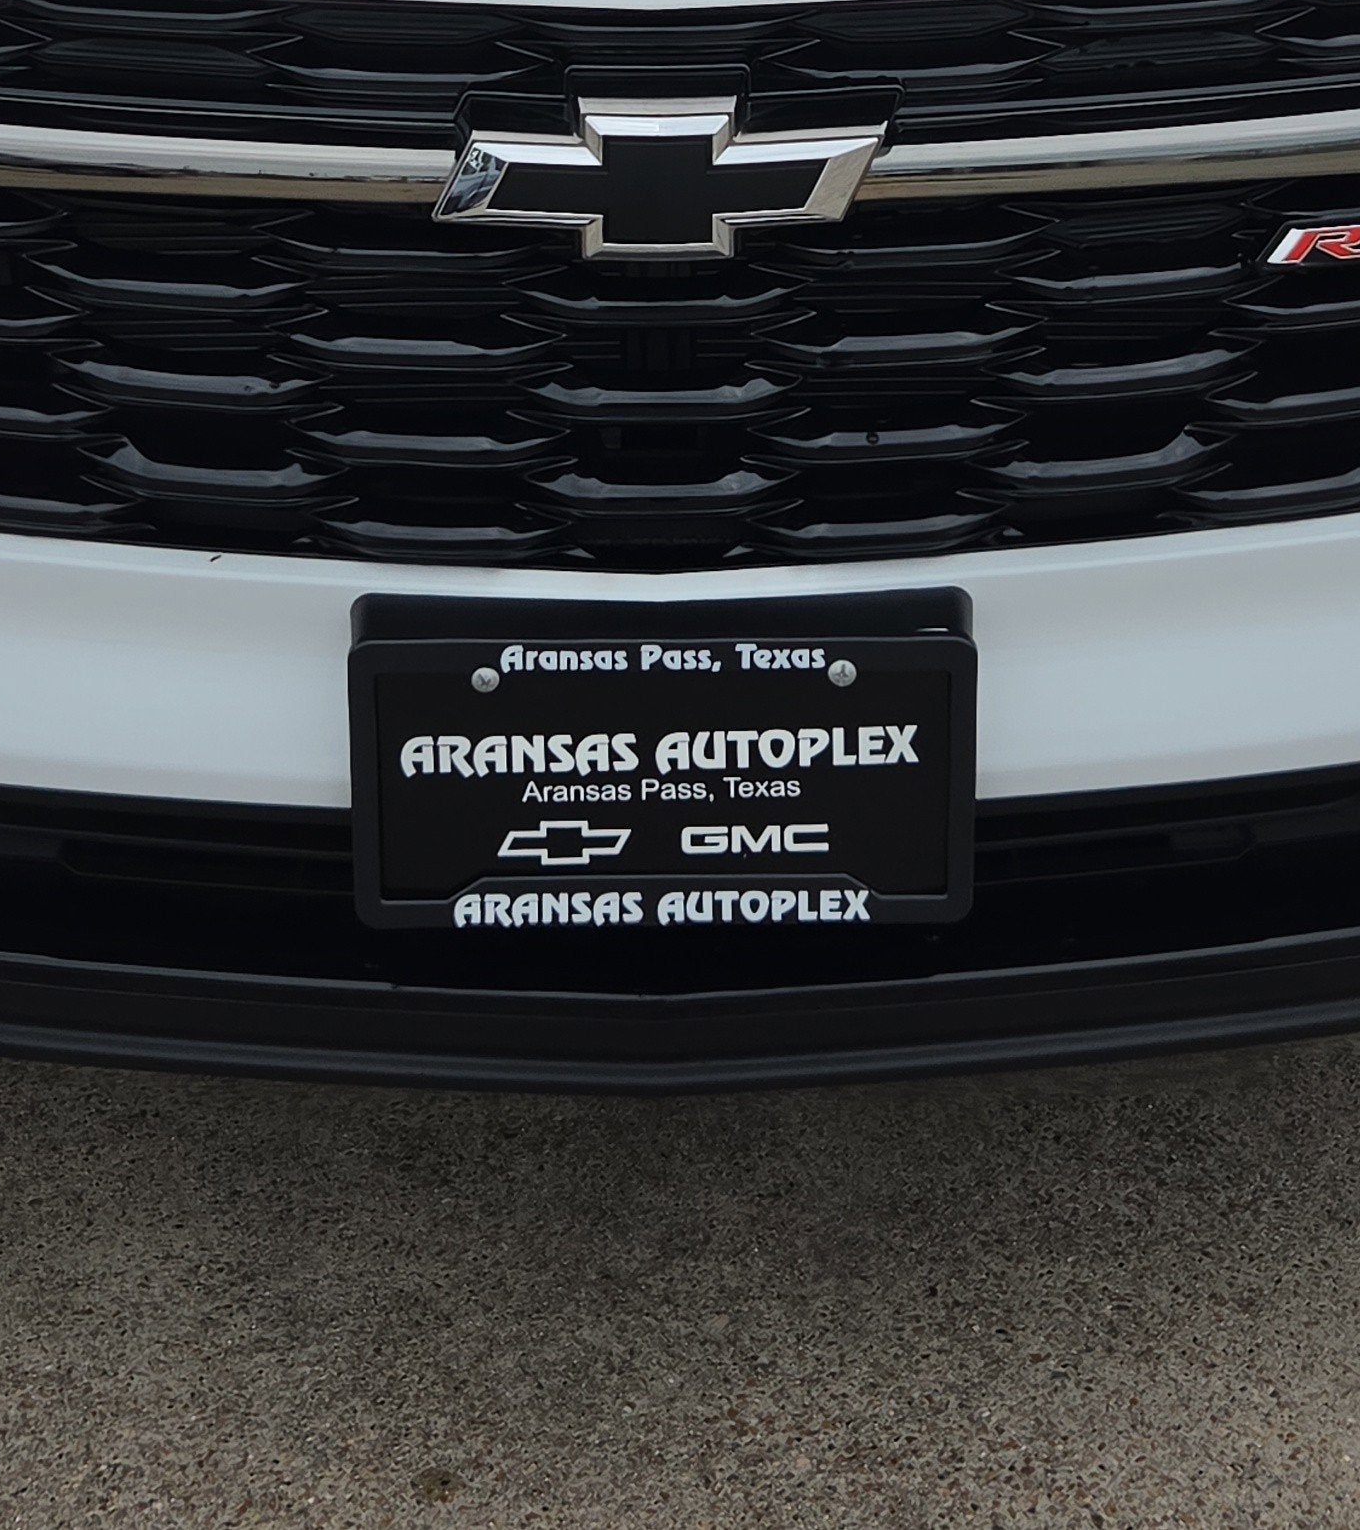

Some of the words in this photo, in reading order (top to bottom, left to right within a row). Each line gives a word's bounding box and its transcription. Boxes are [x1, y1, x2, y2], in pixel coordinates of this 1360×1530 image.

[500, 645, 628, 673] Aransas
[640, 644, 722, 672] Pass,
[736, 644, 826, 669] Texas
[399, 733, 639, 778] ARANSAS
[655, 724, 919, 775] AUTOPLEX
[522, 781, 631, 802] Aransas
[642, 779, 714, 802] Pass,
[723, 777, 801, 798] Texas
[681, 824, 829, 856] GMC
[454, 892, 643, 927] ARANSAS
[658, 890, 870, 925] AUTOPLEX
